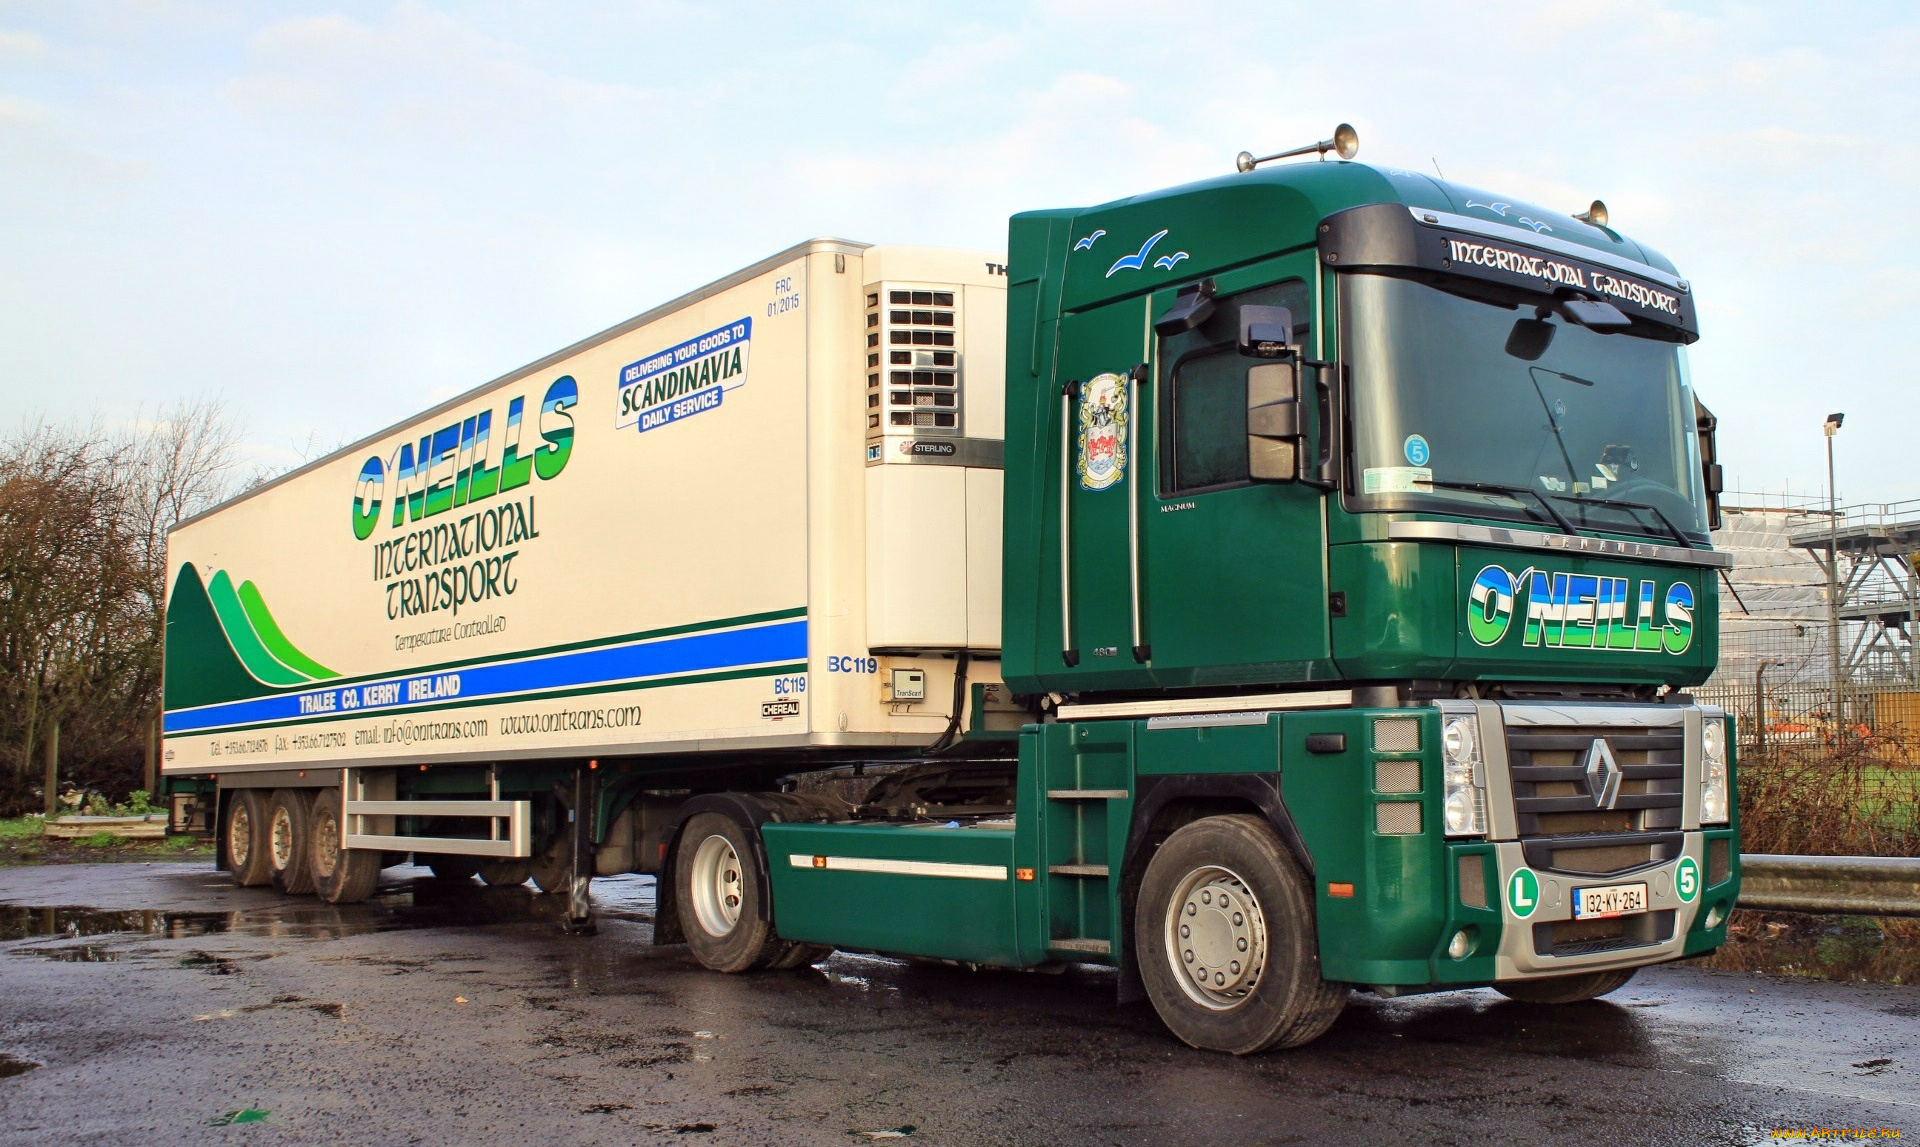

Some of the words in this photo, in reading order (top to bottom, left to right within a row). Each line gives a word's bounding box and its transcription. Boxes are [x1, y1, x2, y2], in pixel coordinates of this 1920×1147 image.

[775, 277, 792, 295] FRC
[1450, 240, 1587, 289] INTERNATIONAL
[1591, 271, 1678, 315] TRANSPORT
[767, 294, 799, 317] 01/2015
[625, 352, 672, 382] DELIVERING
[674, 343, 698, 363] YOUR
[699, 330, 730, 352] GOODS
[732, 324, 744, 339] TO
[622, 346, 743, 416] SCANDINAVIA
[642, 408, 671, 430] DAILY
[674, 390, 719, 418] SERVICE
[352, 375, 578, 541] O'NEILLS
[914, 444, 953, 453] STERLING
[1412, 445, 1424, 462] 5
[1160, 502, 1195, 513] MAGNUM
[374, 495, 539, 581] INTERNATIONAL
[1542, 534, 1659, 558] RENAULT
[386, 550, 519, 620] TRANSPORT
[1468, 565, 1694, 656] O'NEILLS
[394, 626, 452, 653] Temperature
[454, 615, 507, 641] Controlled
[827, 656, 878, 674] BC119
[299, 692, 336, 714] TRALEE
[342, 688, 360, 709] CO.
[363, 682, 401, 707] KERRY
[407, 674, 461, 702] IRELAND
[774, 676, 806, 694] BC119
[500, 705, 642, 736] www.onitrans.com
[762, 703, 799, 716] CHEREAU
[1515, 876, 1532, 907] L
[1681, 866, 1695, 893] 5
[1586, 891, 1641, 913] 132-KY-264
